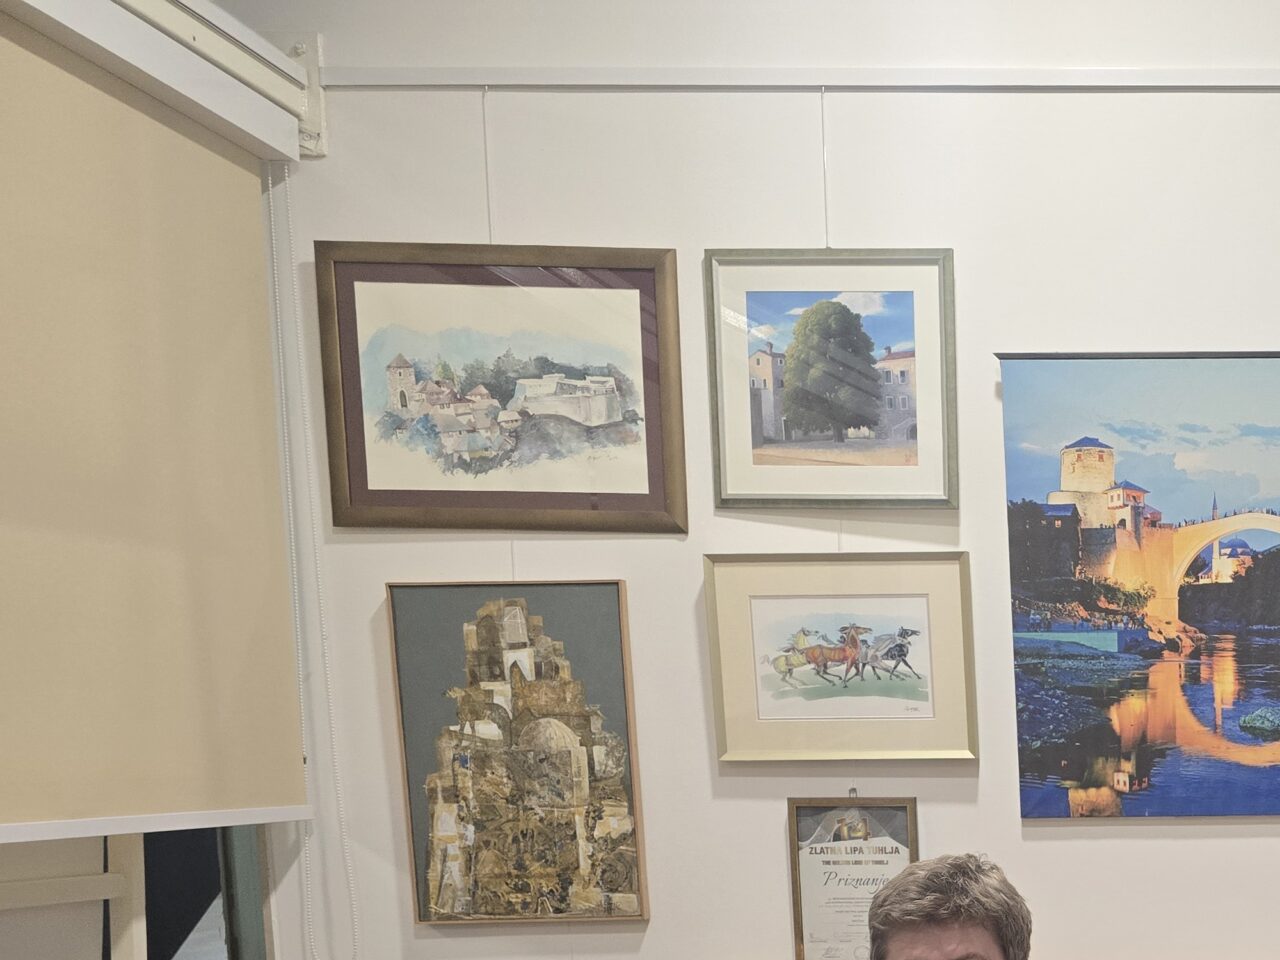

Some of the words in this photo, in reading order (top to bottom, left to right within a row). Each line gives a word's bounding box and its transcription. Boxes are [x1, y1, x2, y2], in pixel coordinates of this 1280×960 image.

[809, 846, 842, 855] ZLATNA
[844, 846, 865, 855] LIPA
[867, 846, 900, 855] TUHLJA
[823, 871, 889, 894] Priznanje
